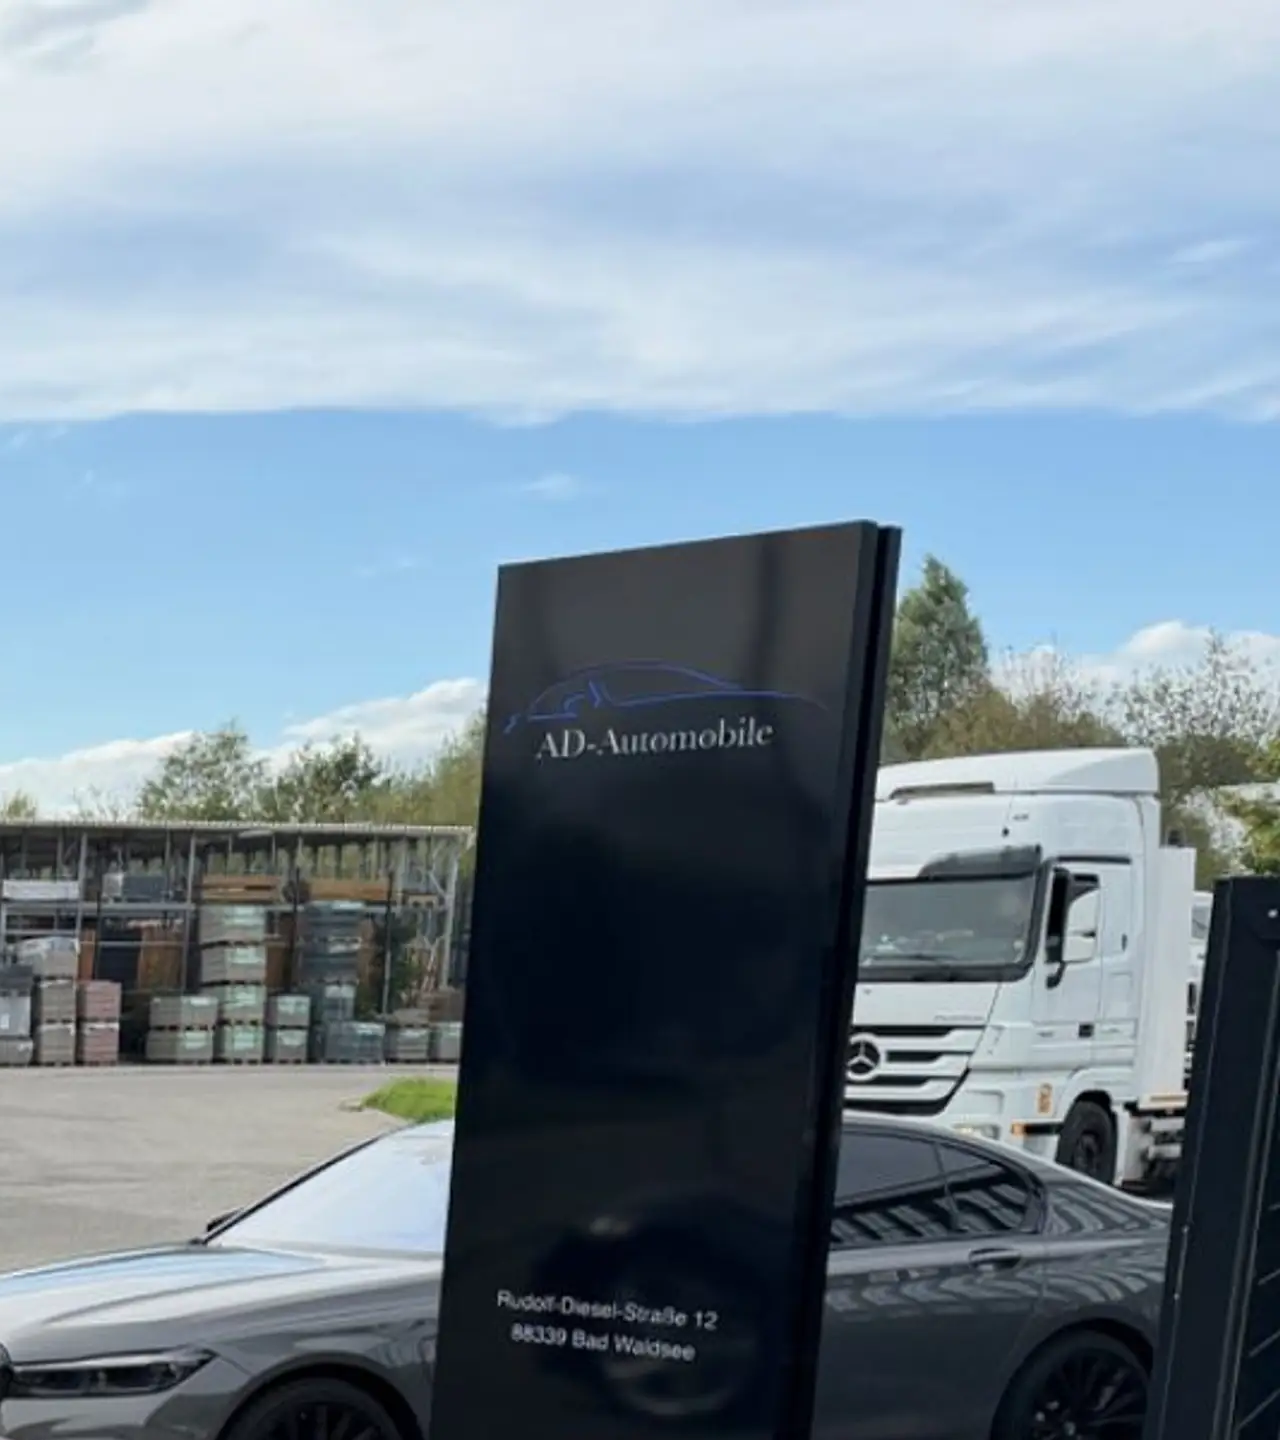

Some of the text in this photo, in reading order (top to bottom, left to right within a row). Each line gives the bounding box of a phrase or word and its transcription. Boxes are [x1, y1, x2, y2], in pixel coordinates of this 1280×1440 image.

[536, 716, 775, 760] AD-Automobile
[496, 1289, 719, 1331] Rudolf-Diesel-Straße 12
[510, 1322, 696, 1362] 88339 Bad Waldsee
